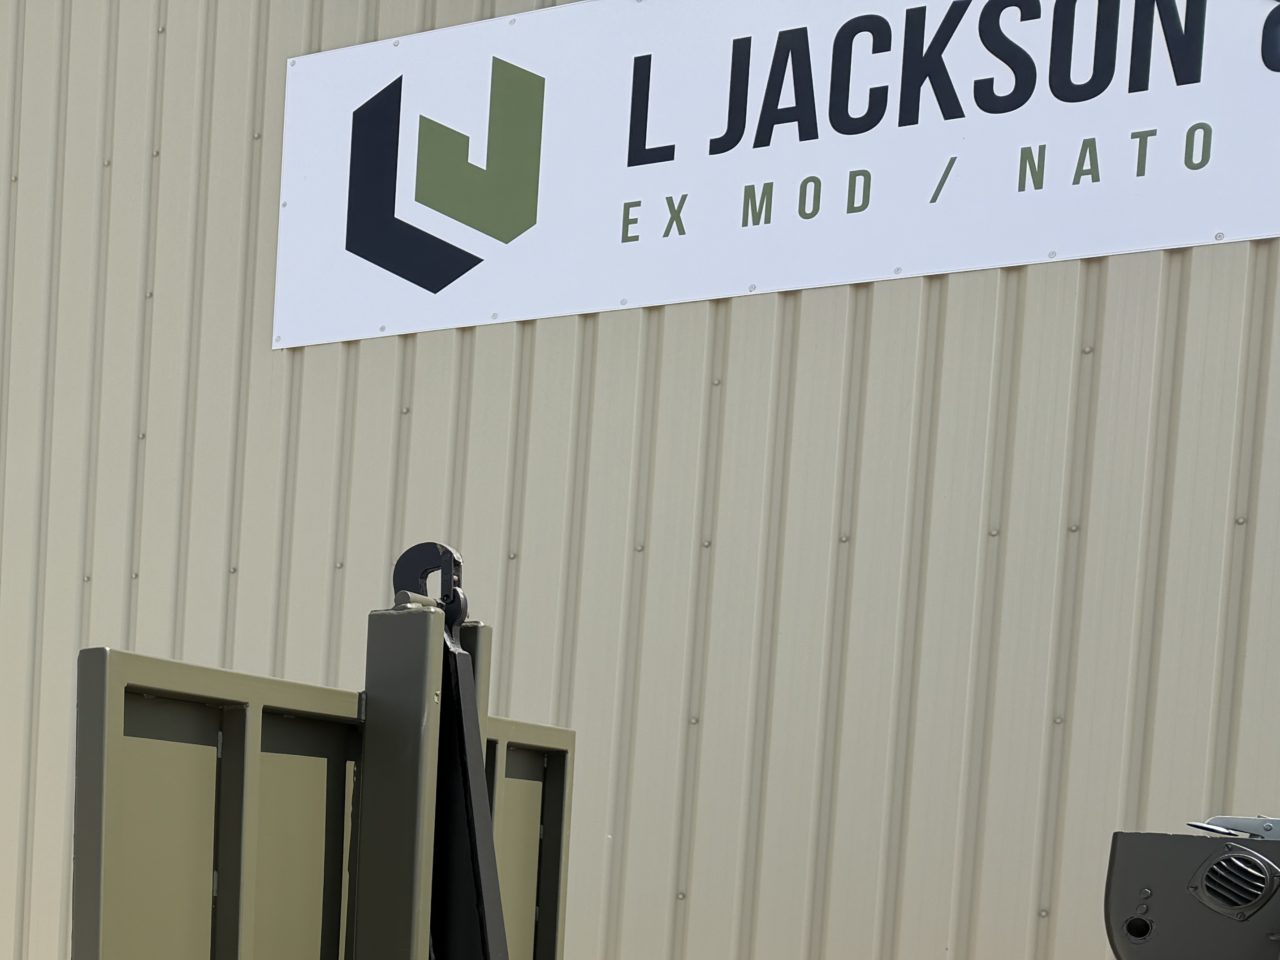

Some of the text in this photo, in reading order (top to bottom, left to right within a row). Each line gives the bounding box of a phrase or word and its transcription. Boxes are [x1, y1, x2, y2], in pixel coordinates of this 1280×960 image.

[627, 54, 676, 168] L
[709, 0, 1207, 155] JACKSON
[622, 194, 688, 243] EX
[742, 170, 871, 227] MOD
[1018, 123, 1212, 192] NATO
